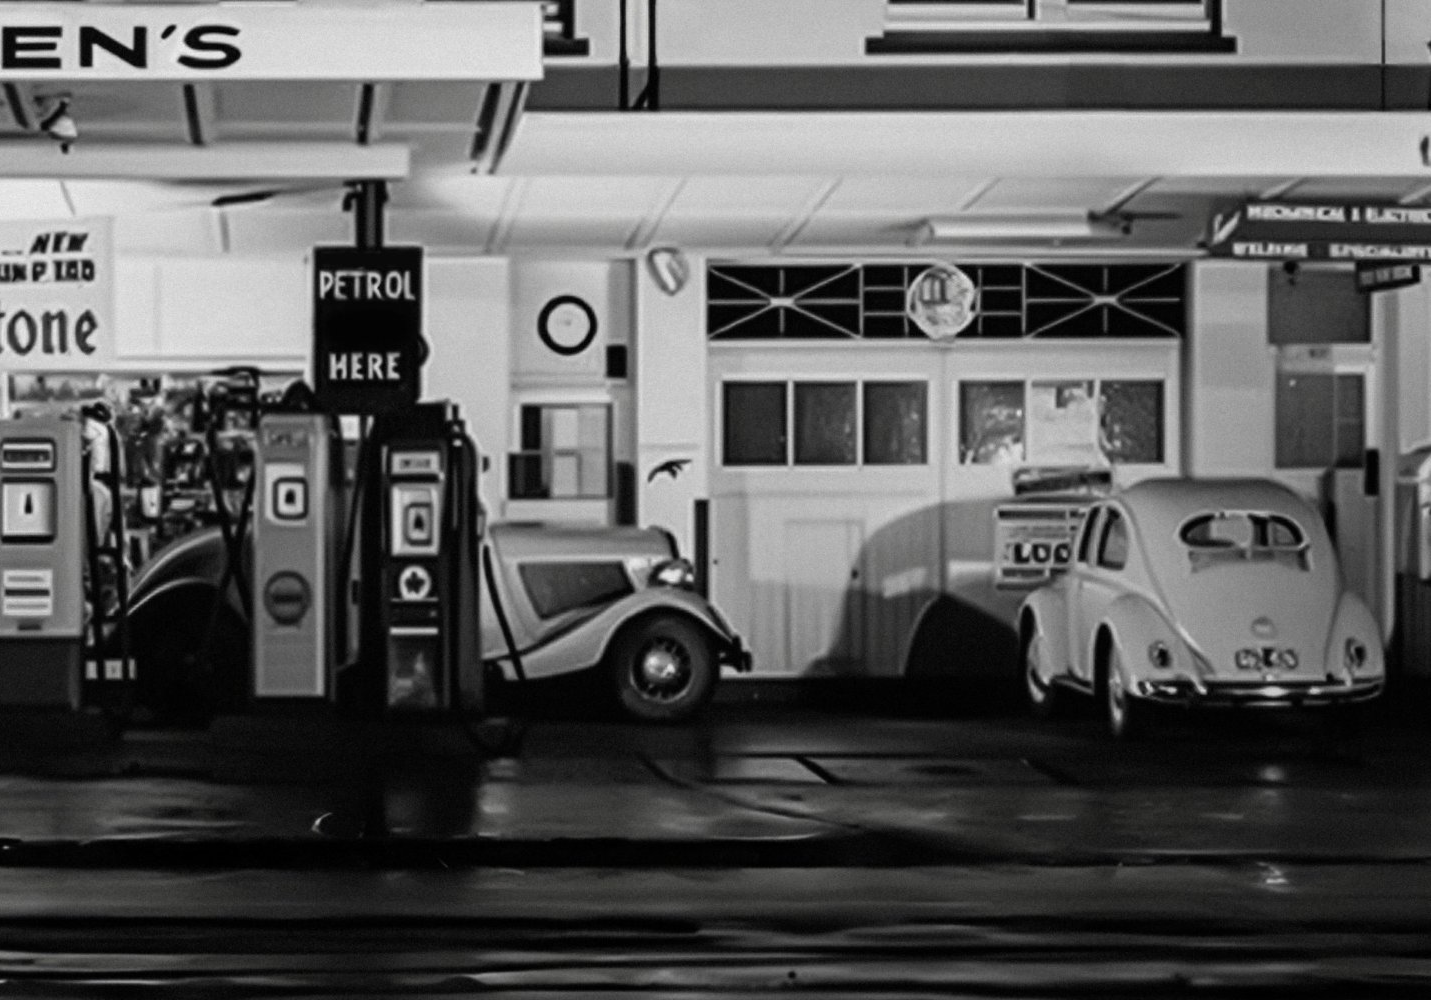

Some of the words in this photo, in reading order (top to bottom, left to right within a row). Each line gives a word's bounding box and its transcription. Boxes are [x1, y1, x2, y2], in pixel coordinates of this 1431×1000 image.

[30, 232, 88, 254] NEW
[320, 271, 414, 299] PETROL
[330, 353, 400, 379] HERE
